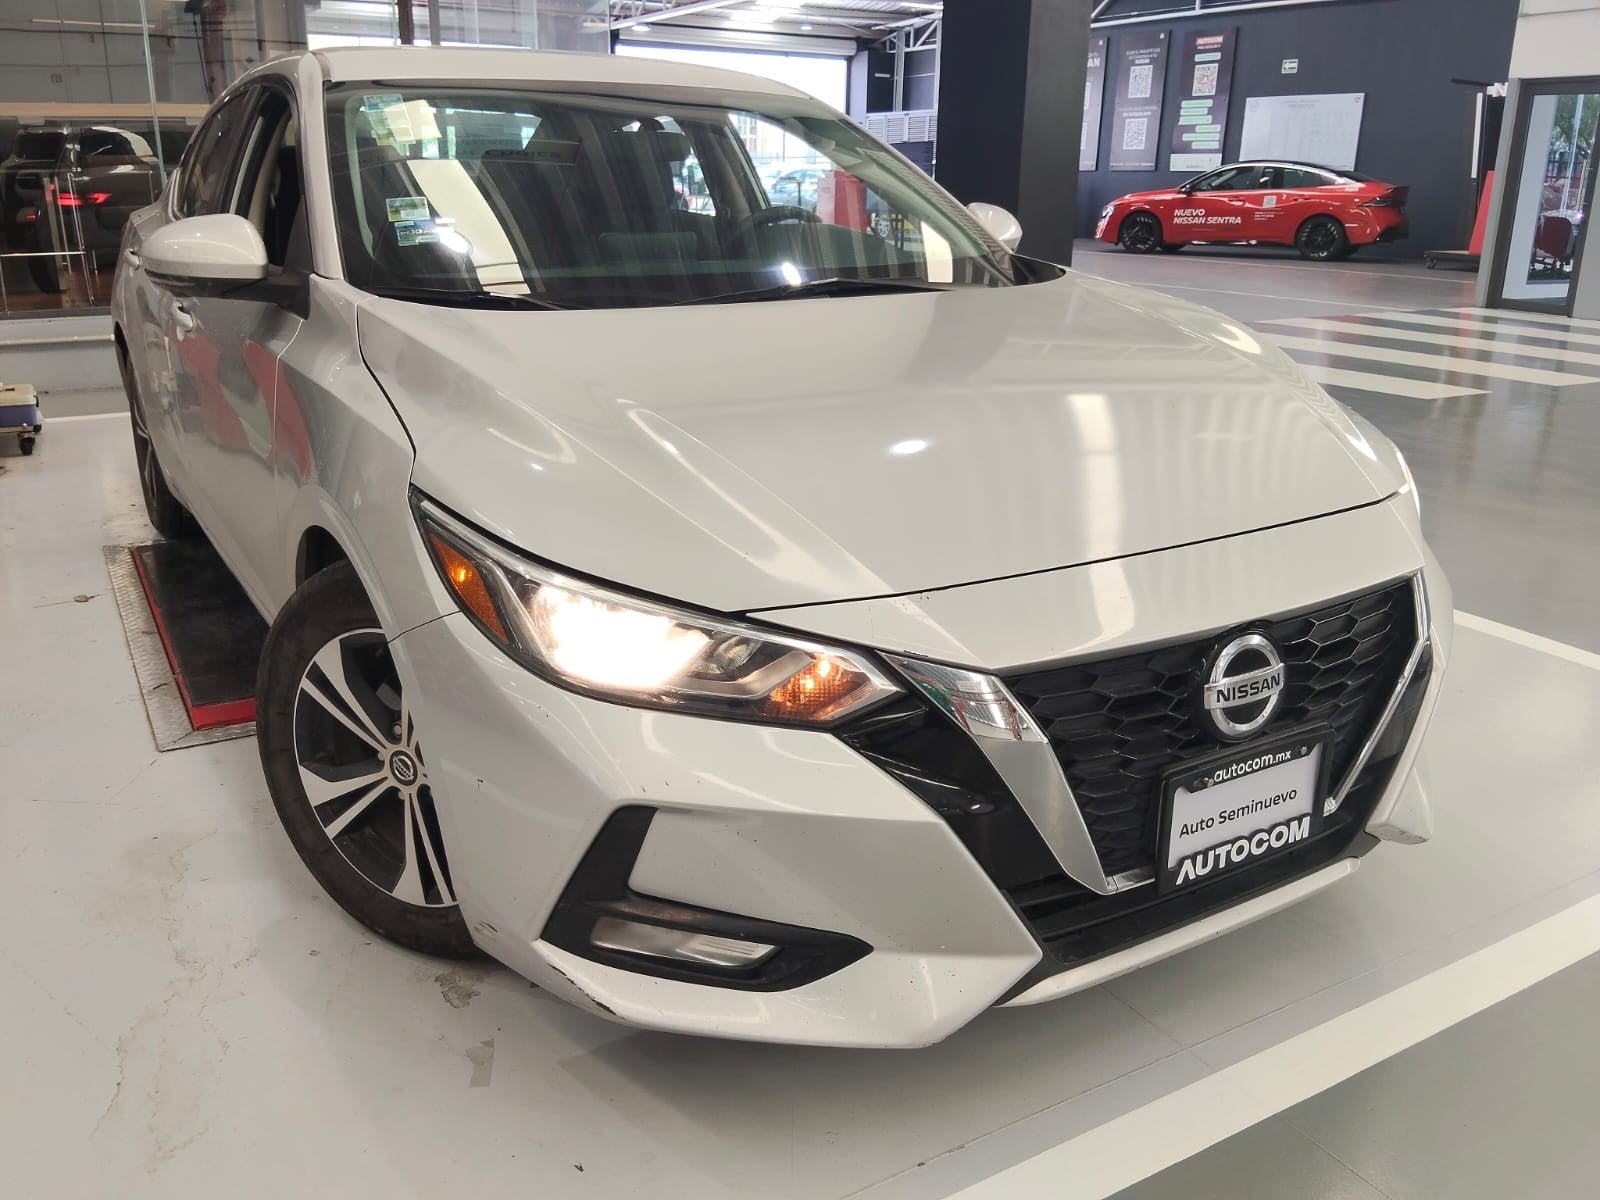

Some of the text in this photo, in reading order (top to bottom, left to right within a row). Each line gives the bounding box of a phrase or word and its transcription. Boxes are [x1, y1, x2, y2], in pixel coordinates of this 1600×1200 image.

[1173, 216, 1242, 225] NISSAN SENTRA
[1174, 208, 1206, 217] NUEVO
[1216, 671, 1281, 705] NISSAN
[1213, 750, 1292, 783] autocom.mx
[1179, 788, 1298, 838] Auto Seminuevo
[1175, 815, 1311, 886] AUTOCOM
